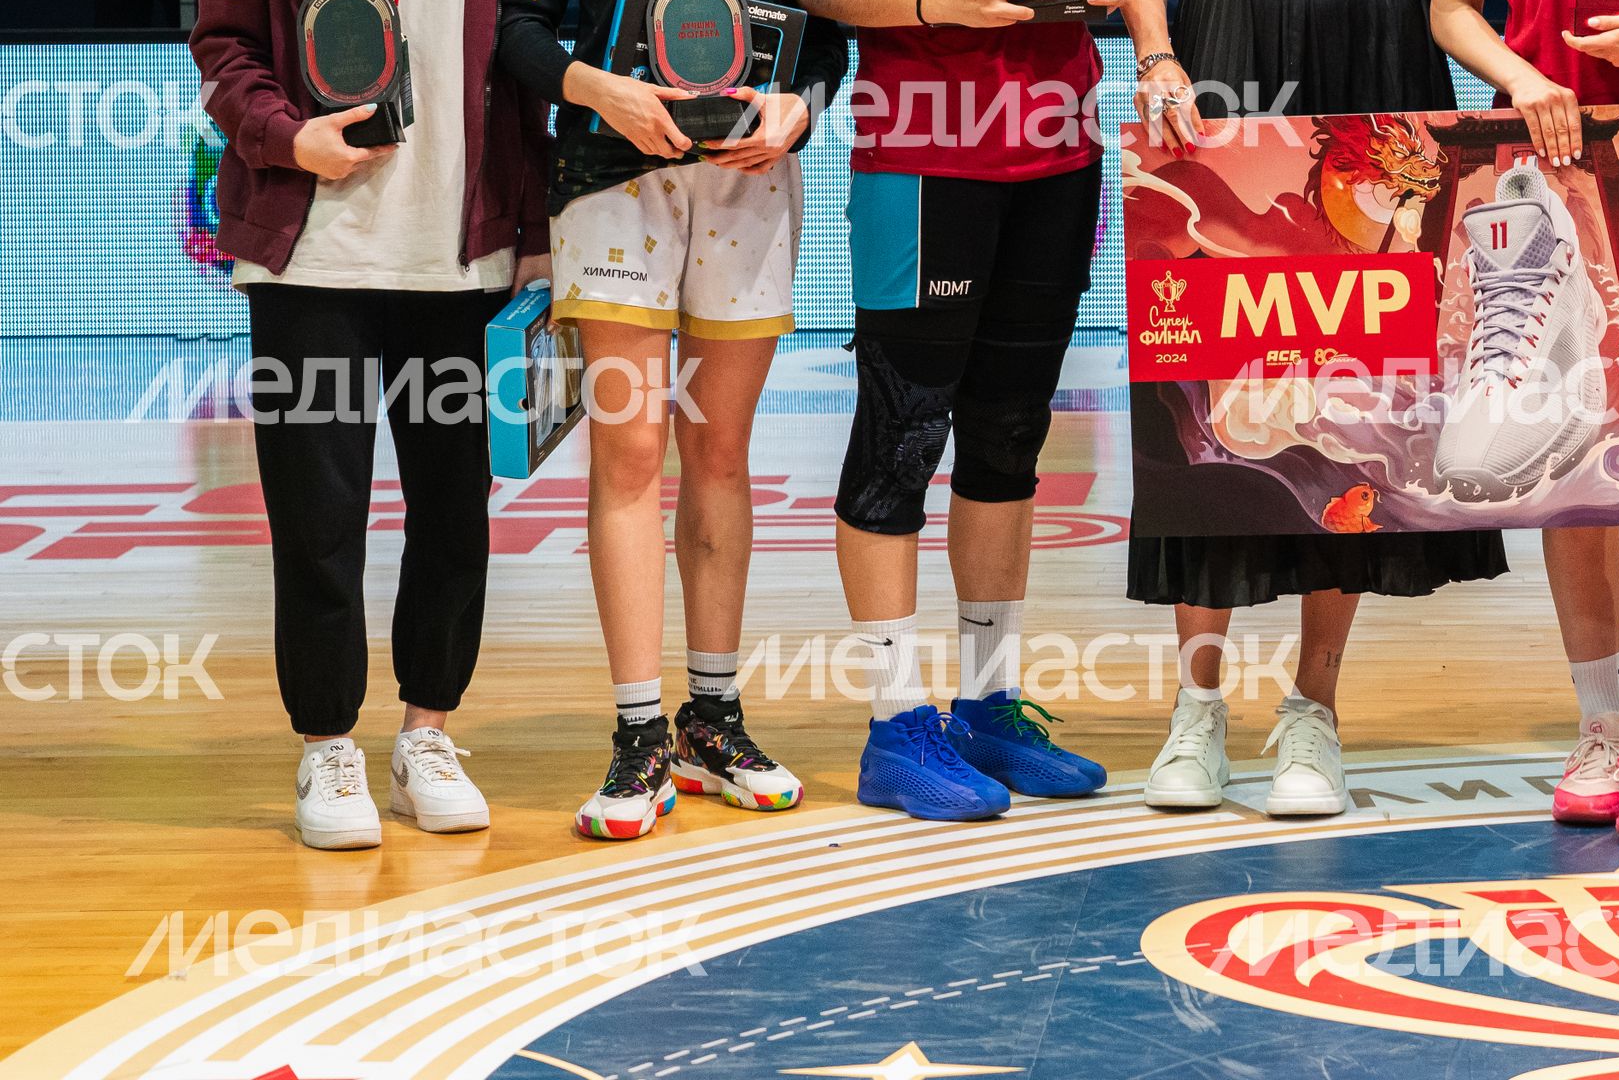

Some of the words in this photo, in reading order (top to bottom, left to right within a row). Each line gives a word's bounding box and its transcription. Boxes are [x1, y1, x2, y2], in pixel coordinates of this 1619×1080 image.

[1490, 221, 1508, 250] 11
[583, 266, 648, 282] ХИМПРОМ
[929, 280, 972, 296] NDMT
[1220, 269, 1411, 338] MVP
[1139, 329, 1202, 346] ФИНАЛ
[1155, 353, 1188, 363] 2024
[1266, 350, 1302, 366] АСБ
